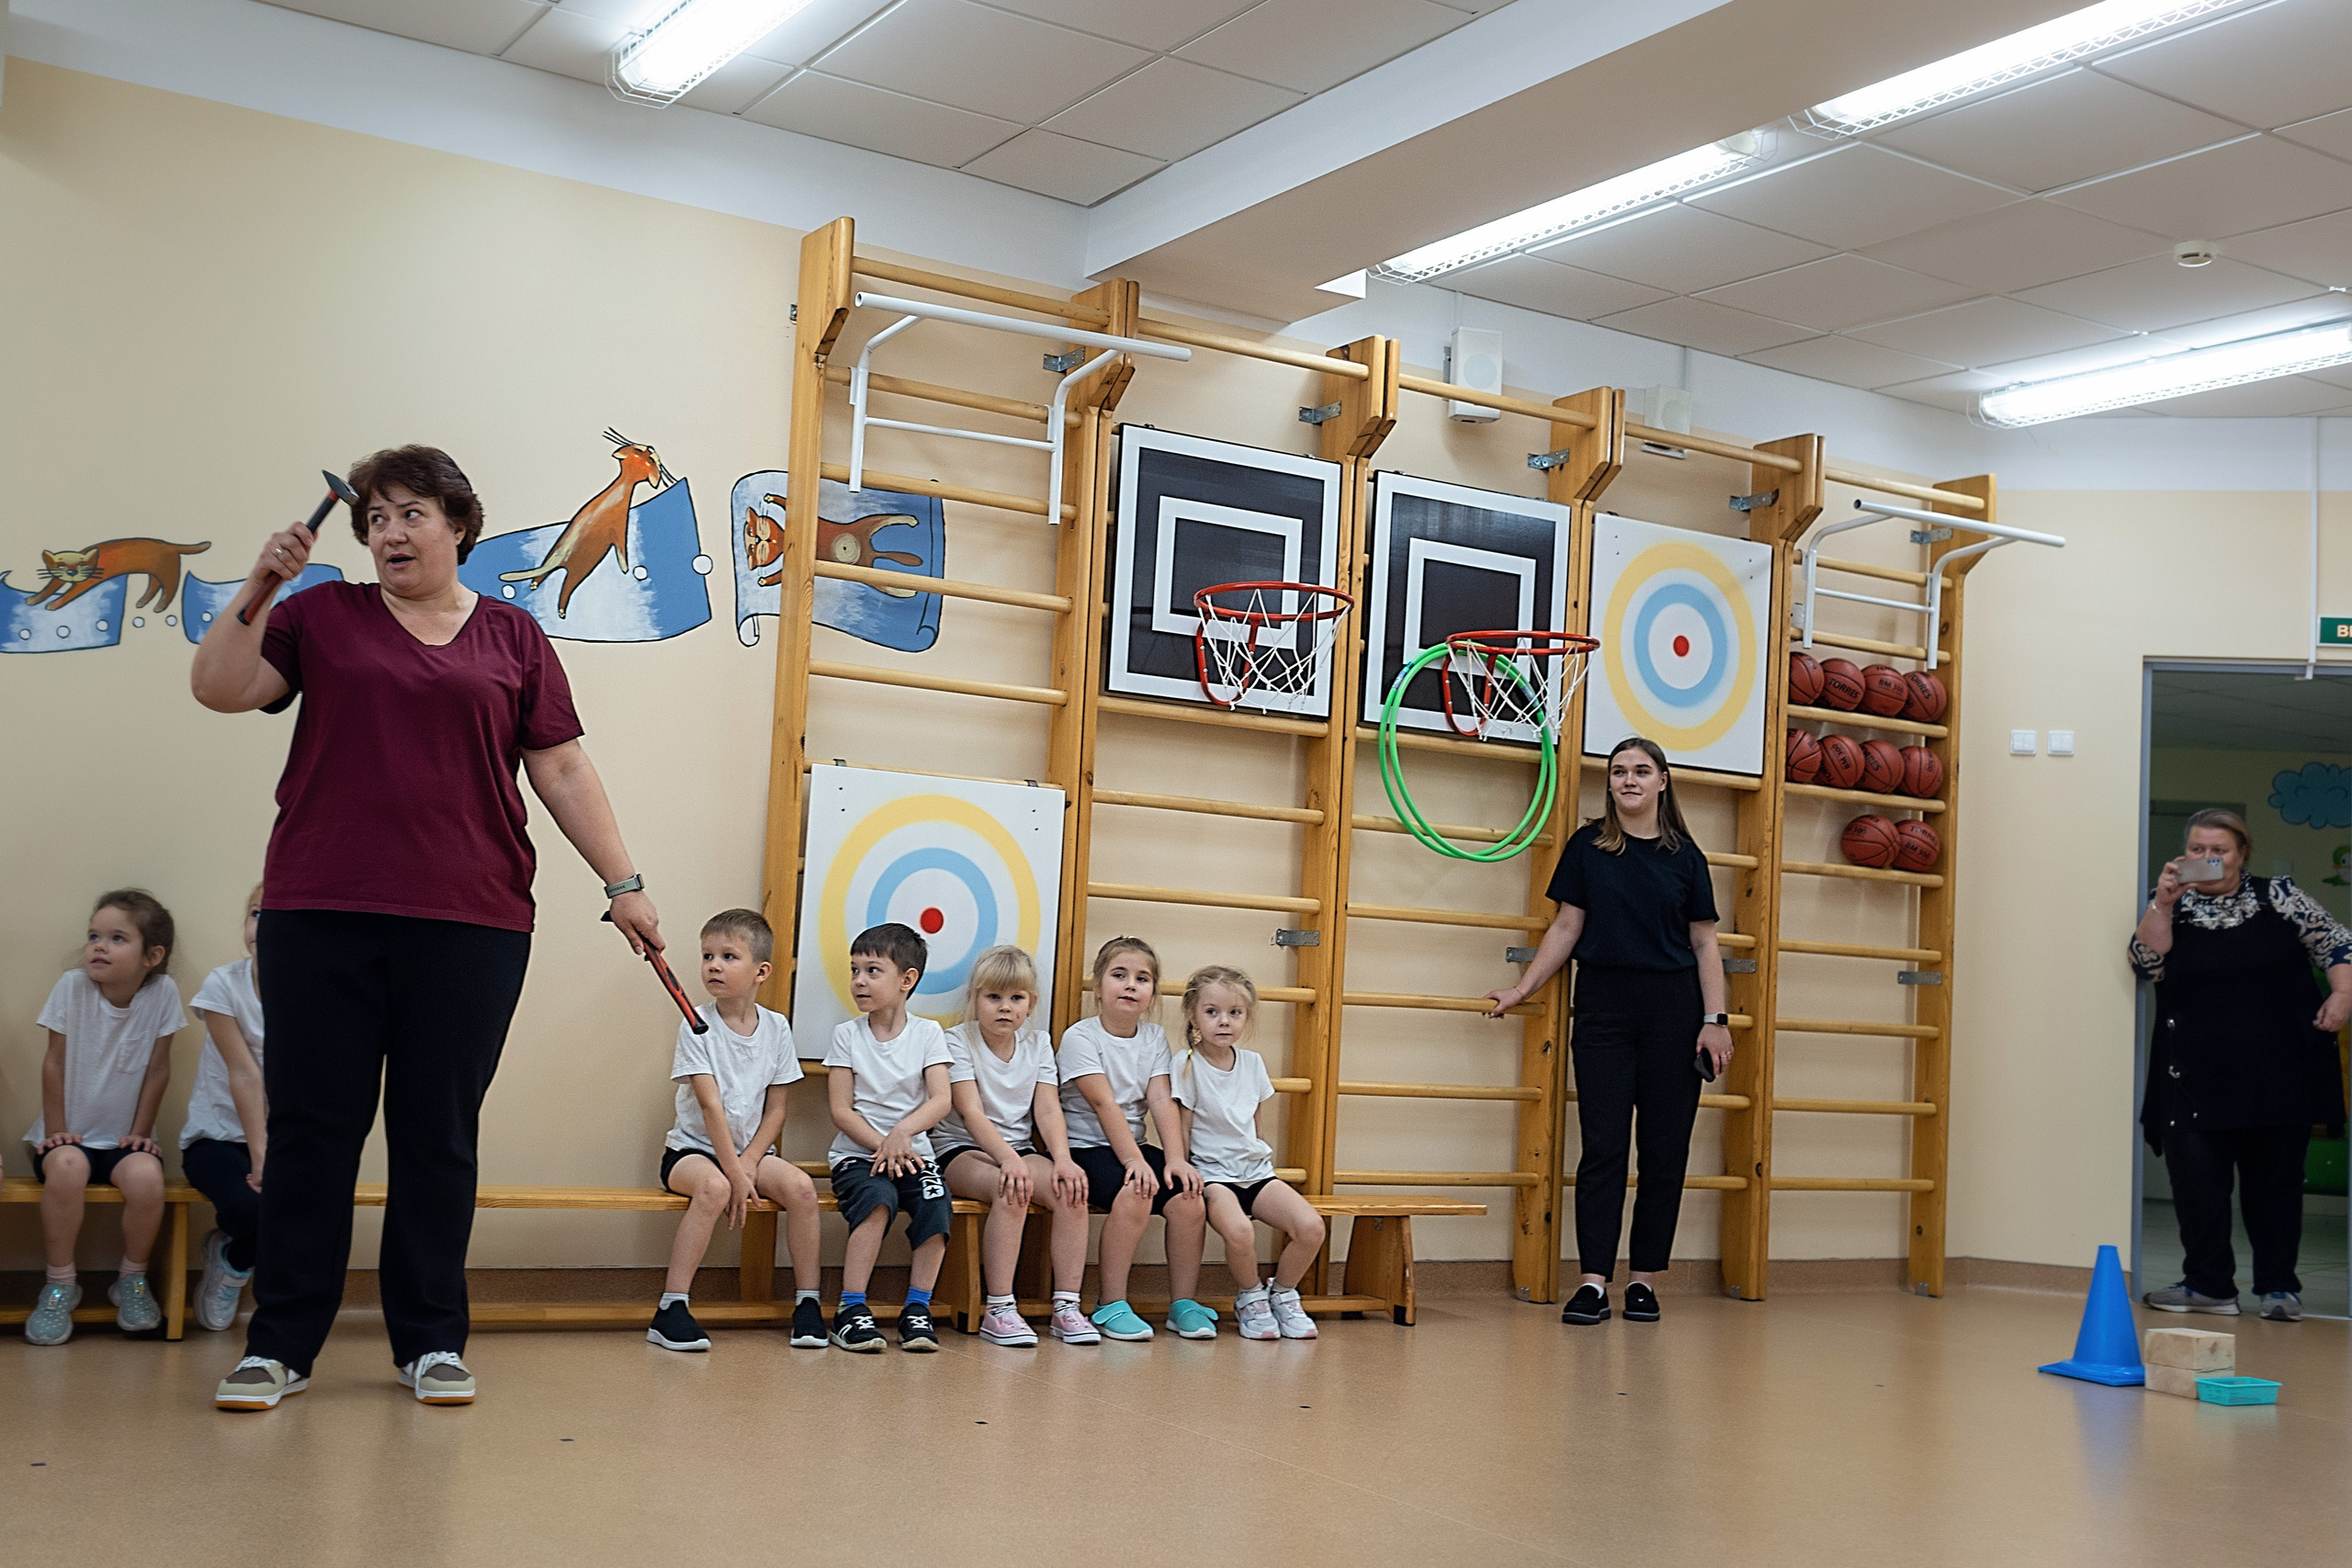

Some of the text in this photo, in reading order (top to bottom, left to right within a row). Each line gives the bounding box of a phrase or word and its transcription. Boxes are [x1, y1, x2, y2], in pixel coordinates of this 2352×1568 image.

[1828, 677, 1860, 699] TORRES
[1878, 679, 1892, 689] BM
[1832, 743, 1850, 770] BM 300
[1905, 841, 1918, 852] BM
